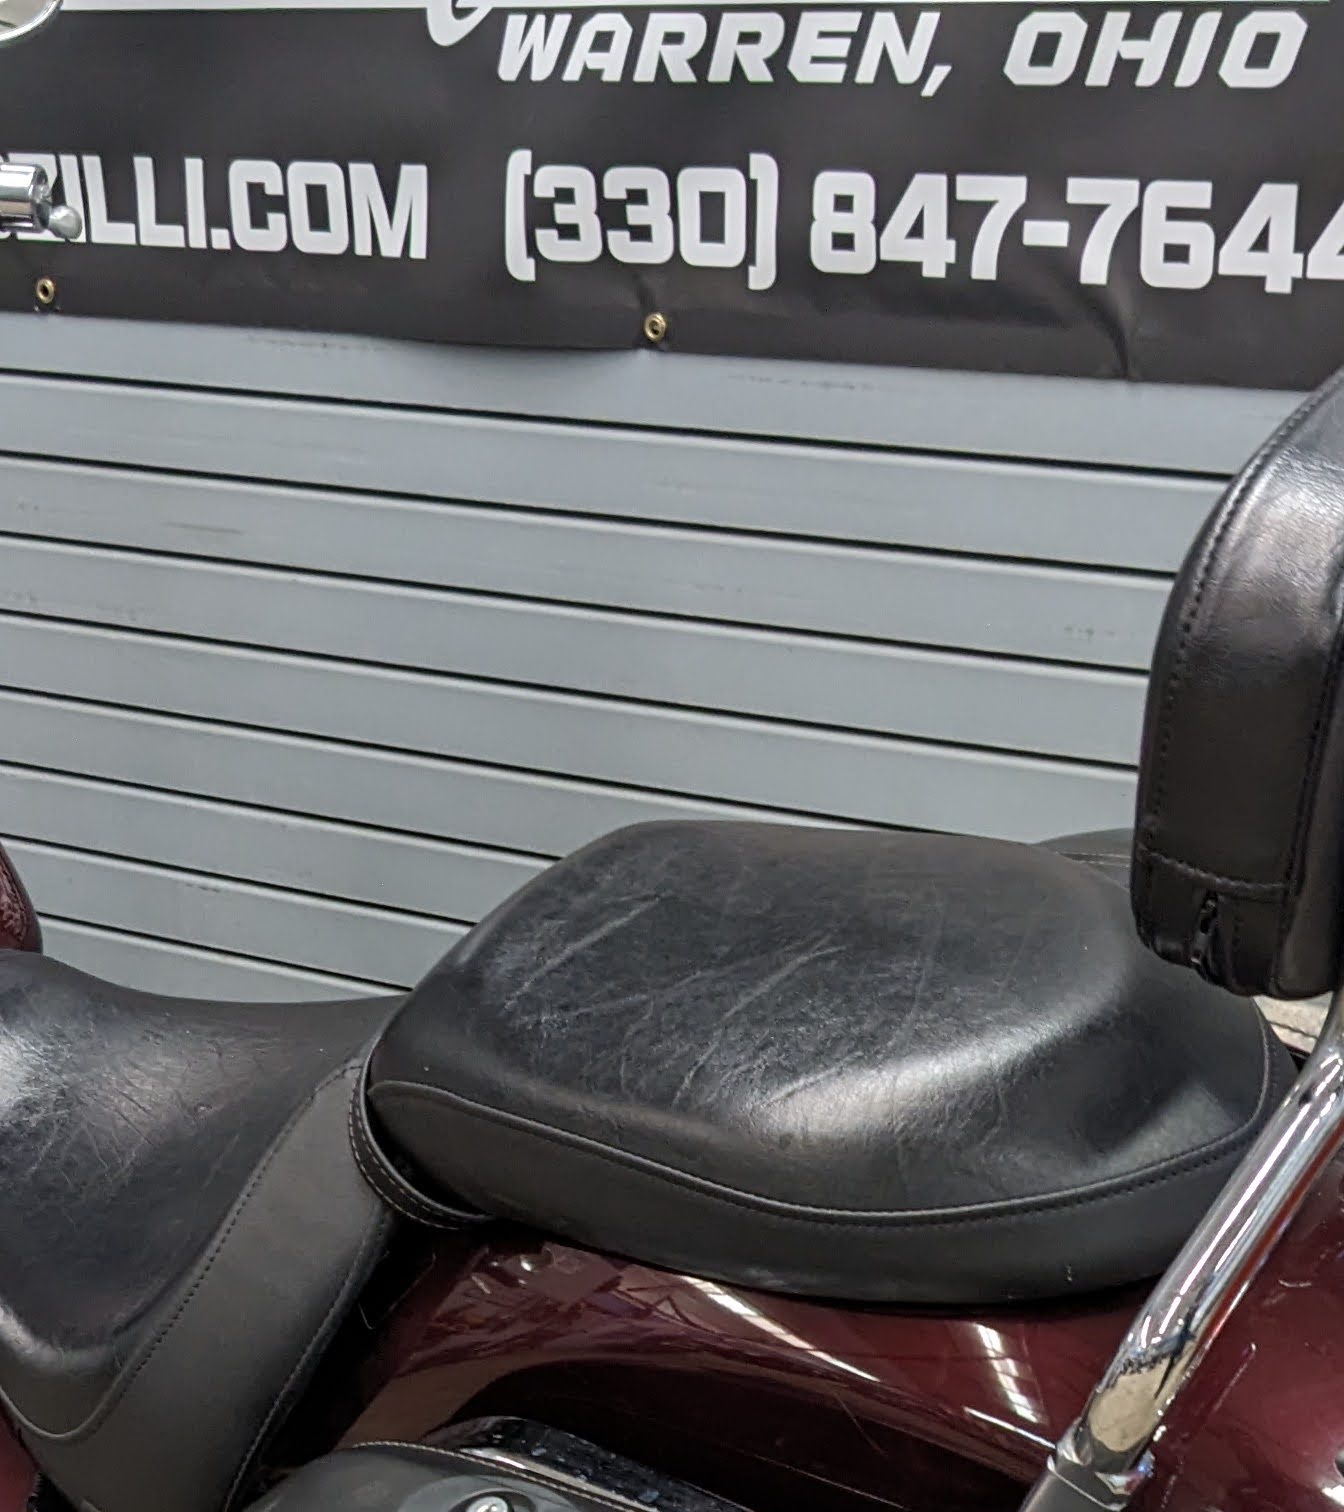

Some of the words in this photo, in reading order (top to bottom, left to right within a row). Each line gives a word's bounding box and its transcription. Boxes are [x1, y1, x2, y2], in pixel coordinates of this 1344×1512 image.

[498, 12, 952, 97] WARREN,
[1003, 11, 1308, 88] OHIO
[505, 149, 779, 290] (330)
